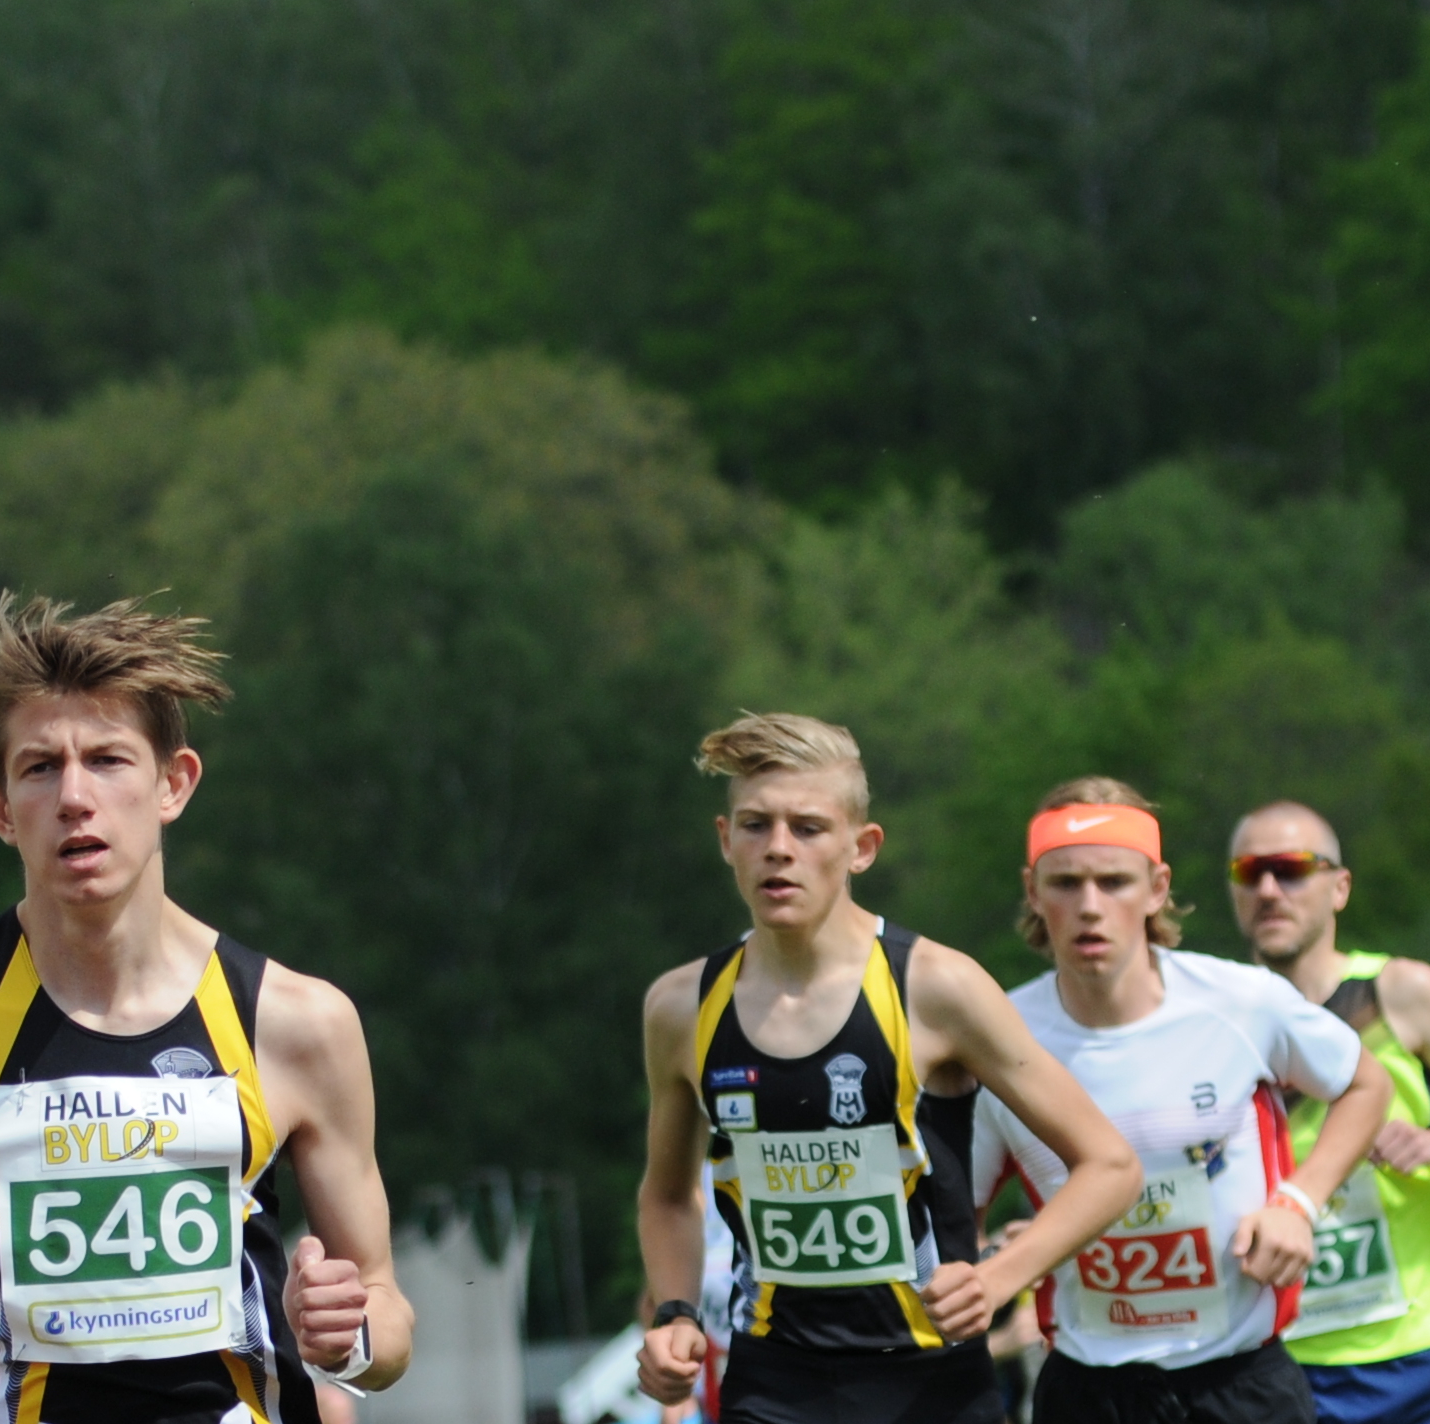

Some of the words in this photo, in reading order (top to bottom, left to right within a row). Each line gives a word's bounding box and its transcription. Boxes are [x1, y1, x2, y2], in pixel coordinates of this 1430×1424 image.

[761, 1139, 861, 1163] HALDEN
[29, 1180, 219, 1277] 546
[763, 1204, 890, 1267] 549
[1304, 1225, 1376, 1285] 57
[1085, 1233, 1207, 1290] 324
[71, 1299, 209, 1334] kynningsrud
